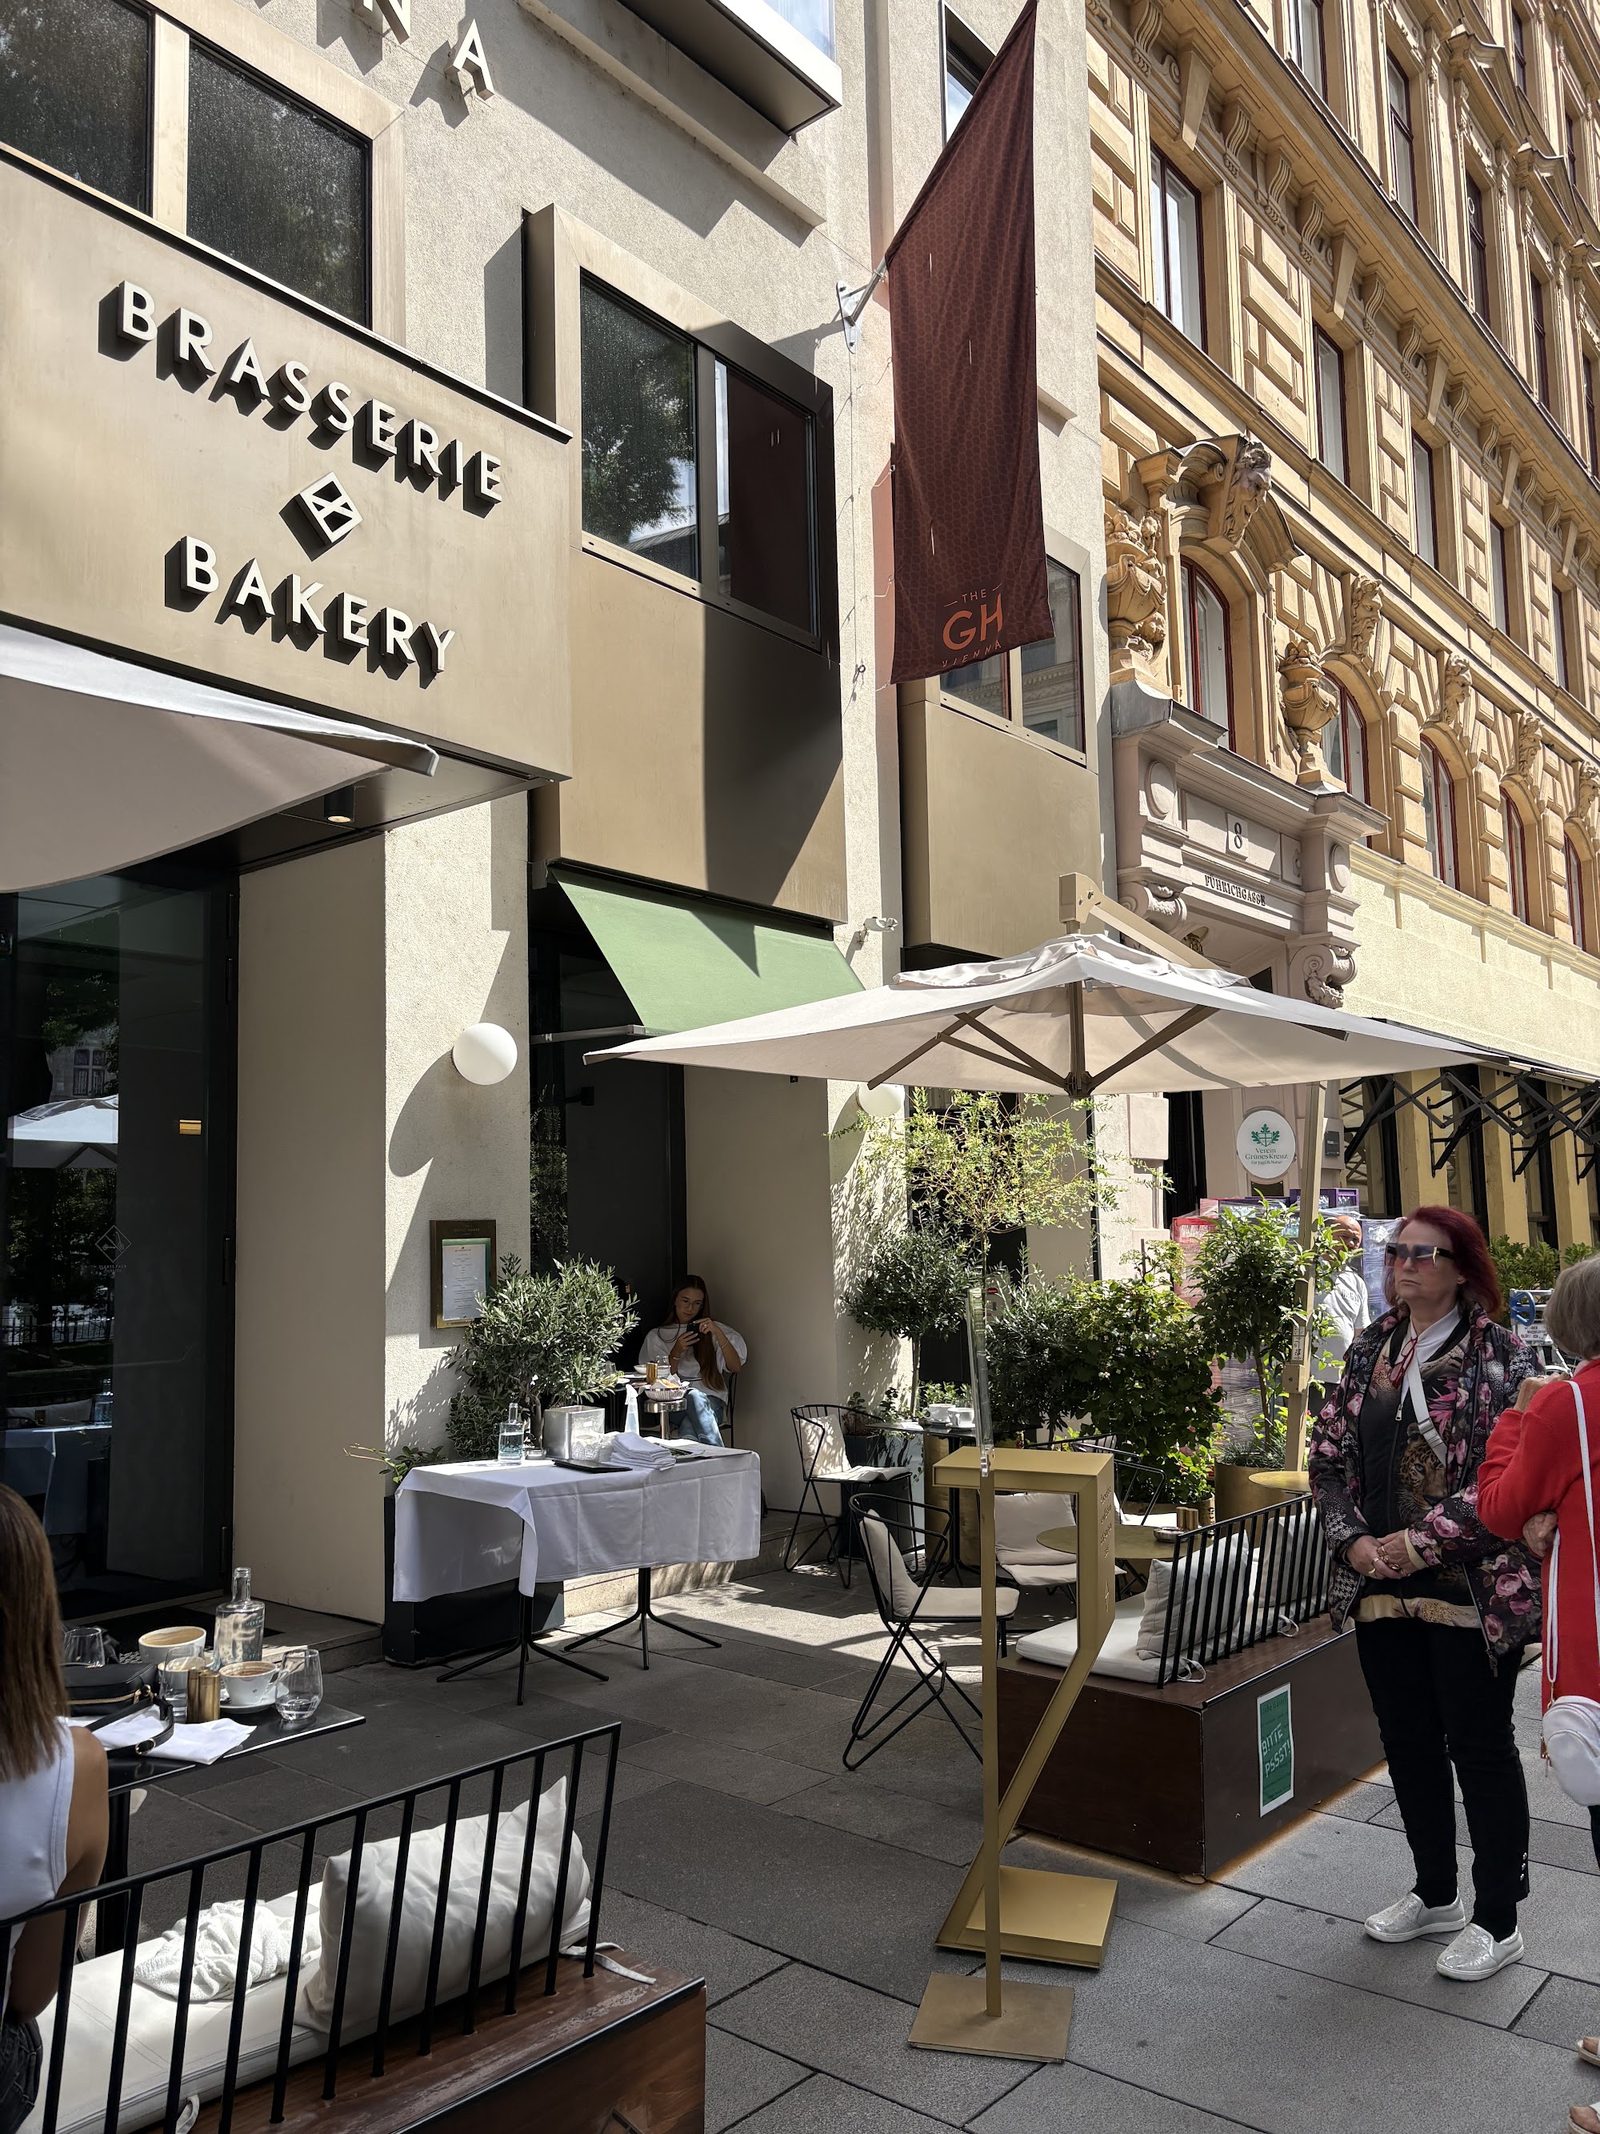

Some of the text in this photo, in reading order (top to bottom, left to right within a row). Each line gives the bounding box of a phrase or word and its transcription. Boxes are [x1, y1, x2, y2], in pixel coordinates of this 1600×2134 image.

[118, 280, 502, 503] BRASSERIE
[182, 535, 455, 673] BAKERY
[962, 588, 987, 603] THE
[942, 593, 1004, 651] GH
[942, 640, 1002, 668] VIENNA
[1233, 822, 1243, 849] 8
[1261, 1723, 1284, 1756] BITTE
